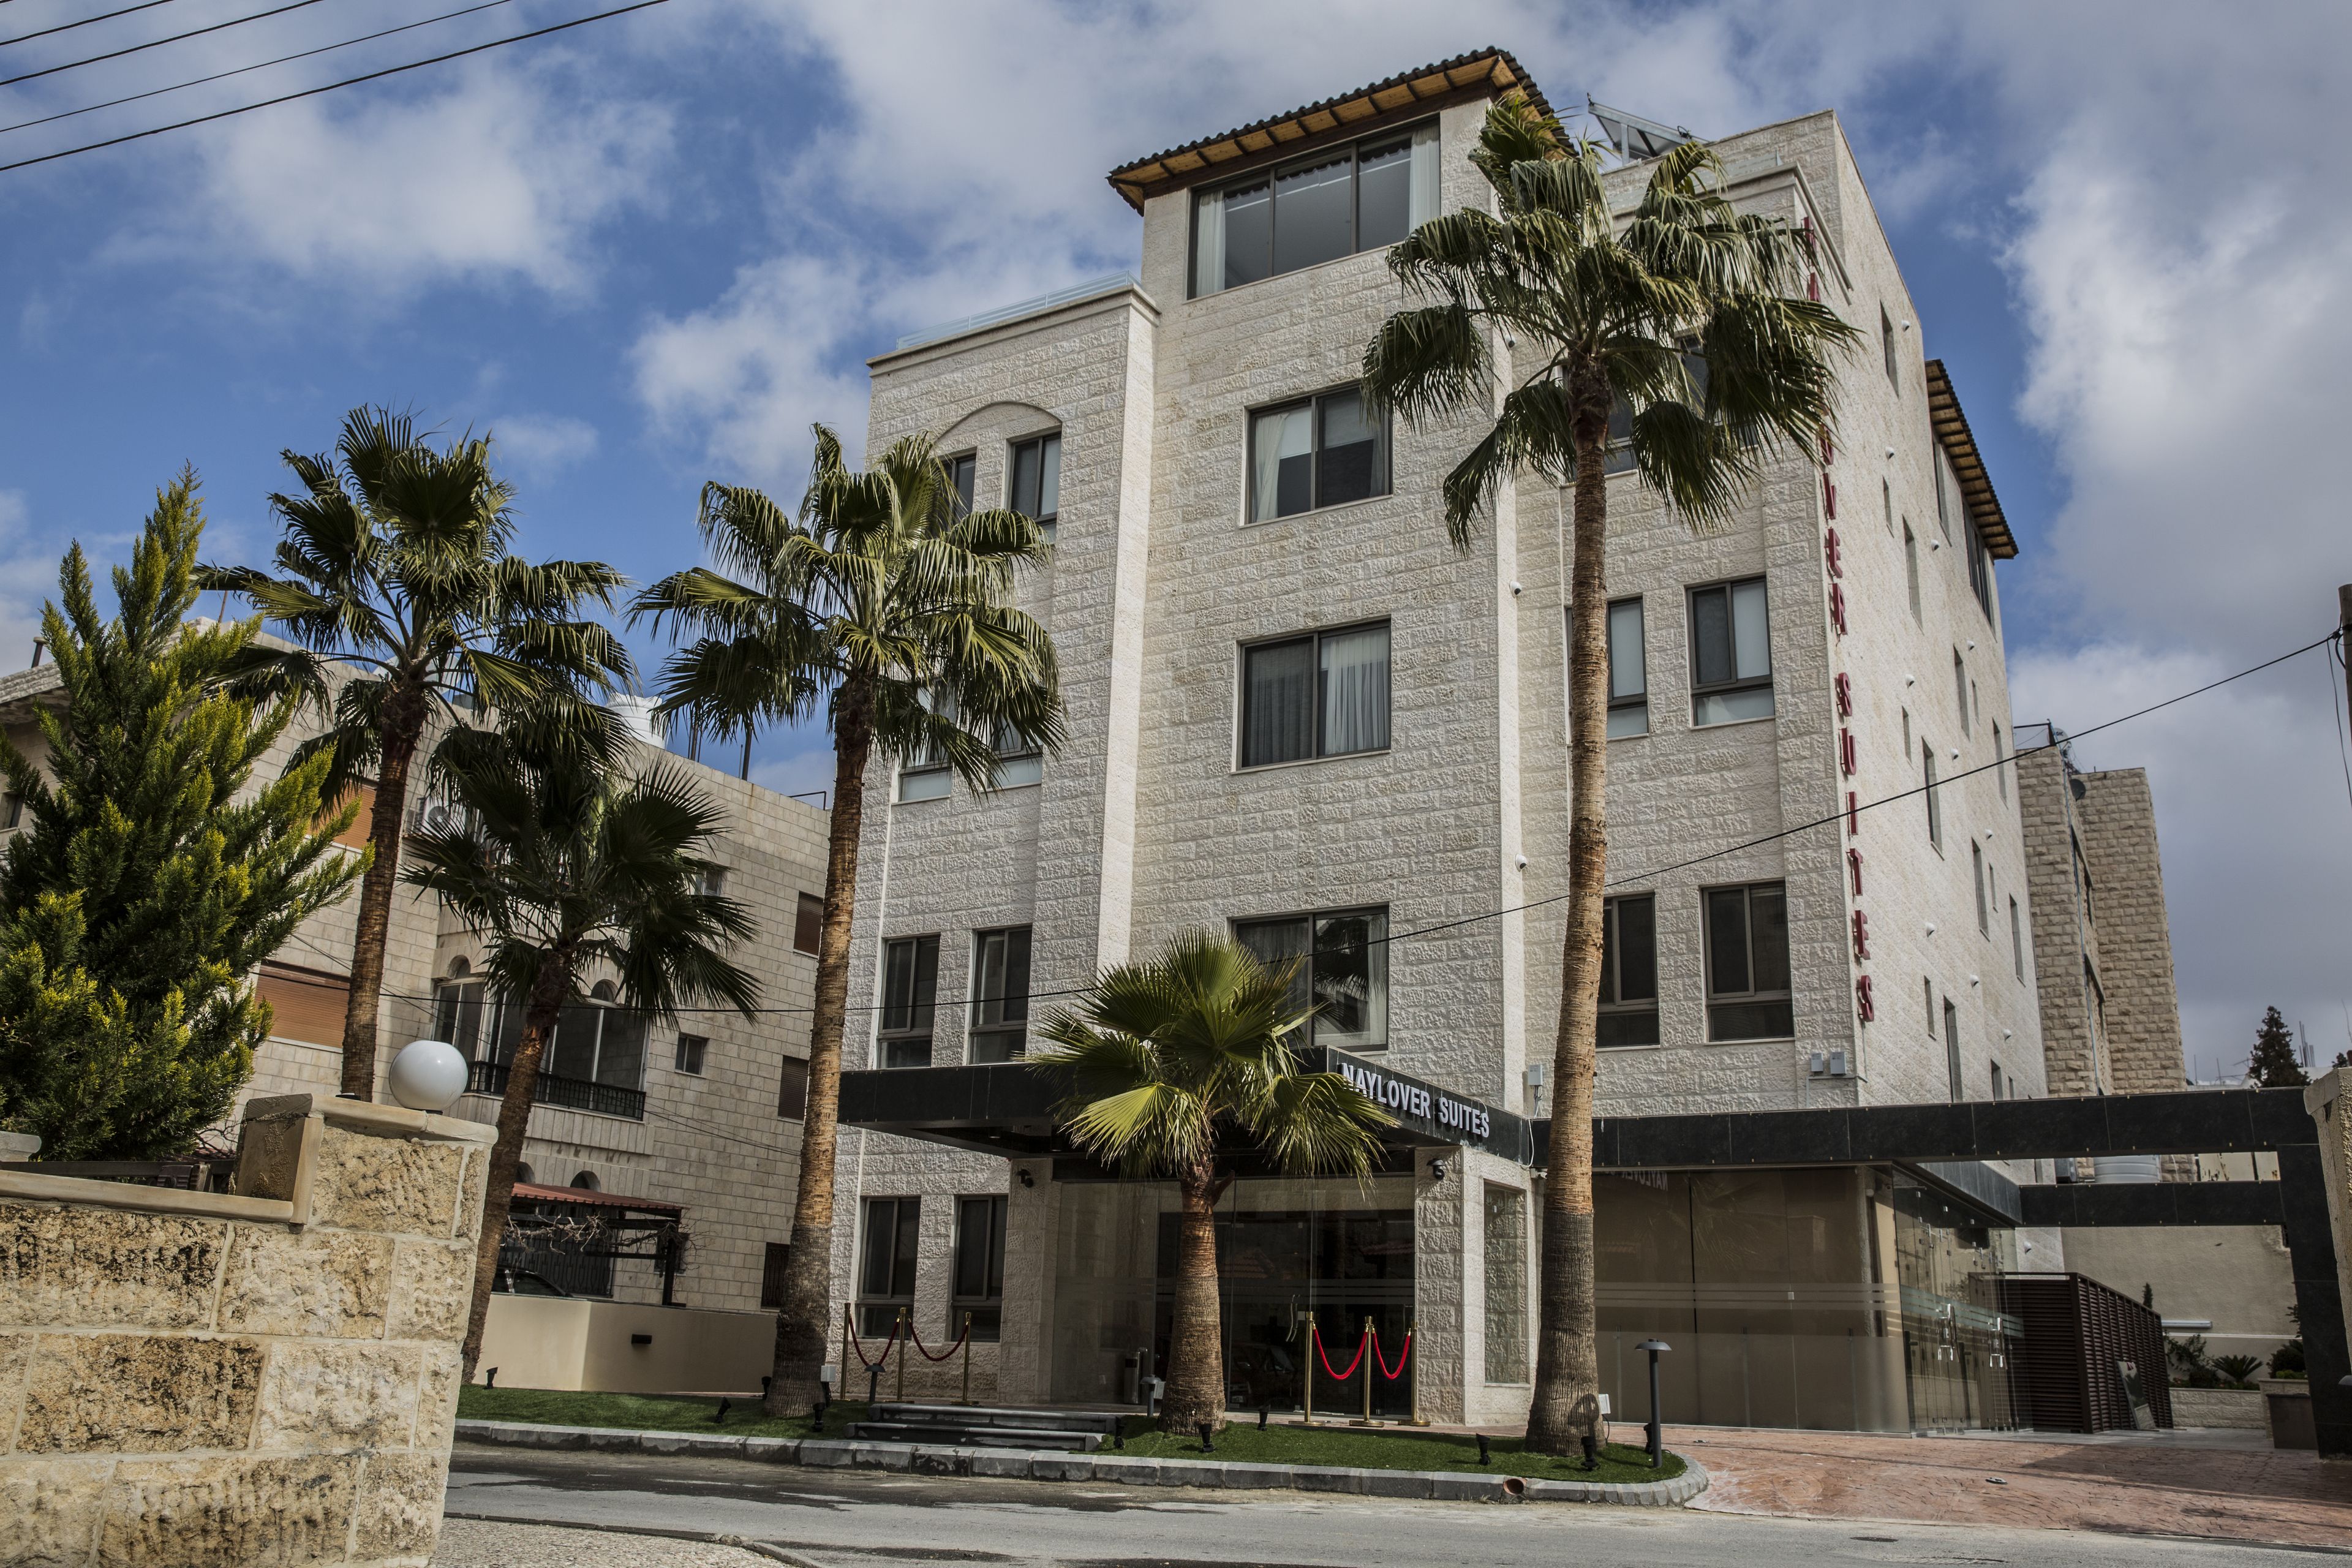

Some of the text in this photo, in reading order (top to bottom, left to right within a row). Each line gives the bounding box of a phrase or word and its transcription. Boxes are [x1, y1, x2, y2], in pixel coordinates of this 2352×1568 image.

[1838, 673, 1874, 1022] SUITES
[1341, 1063, 1490, 1138] NAYLOVER SUITES
